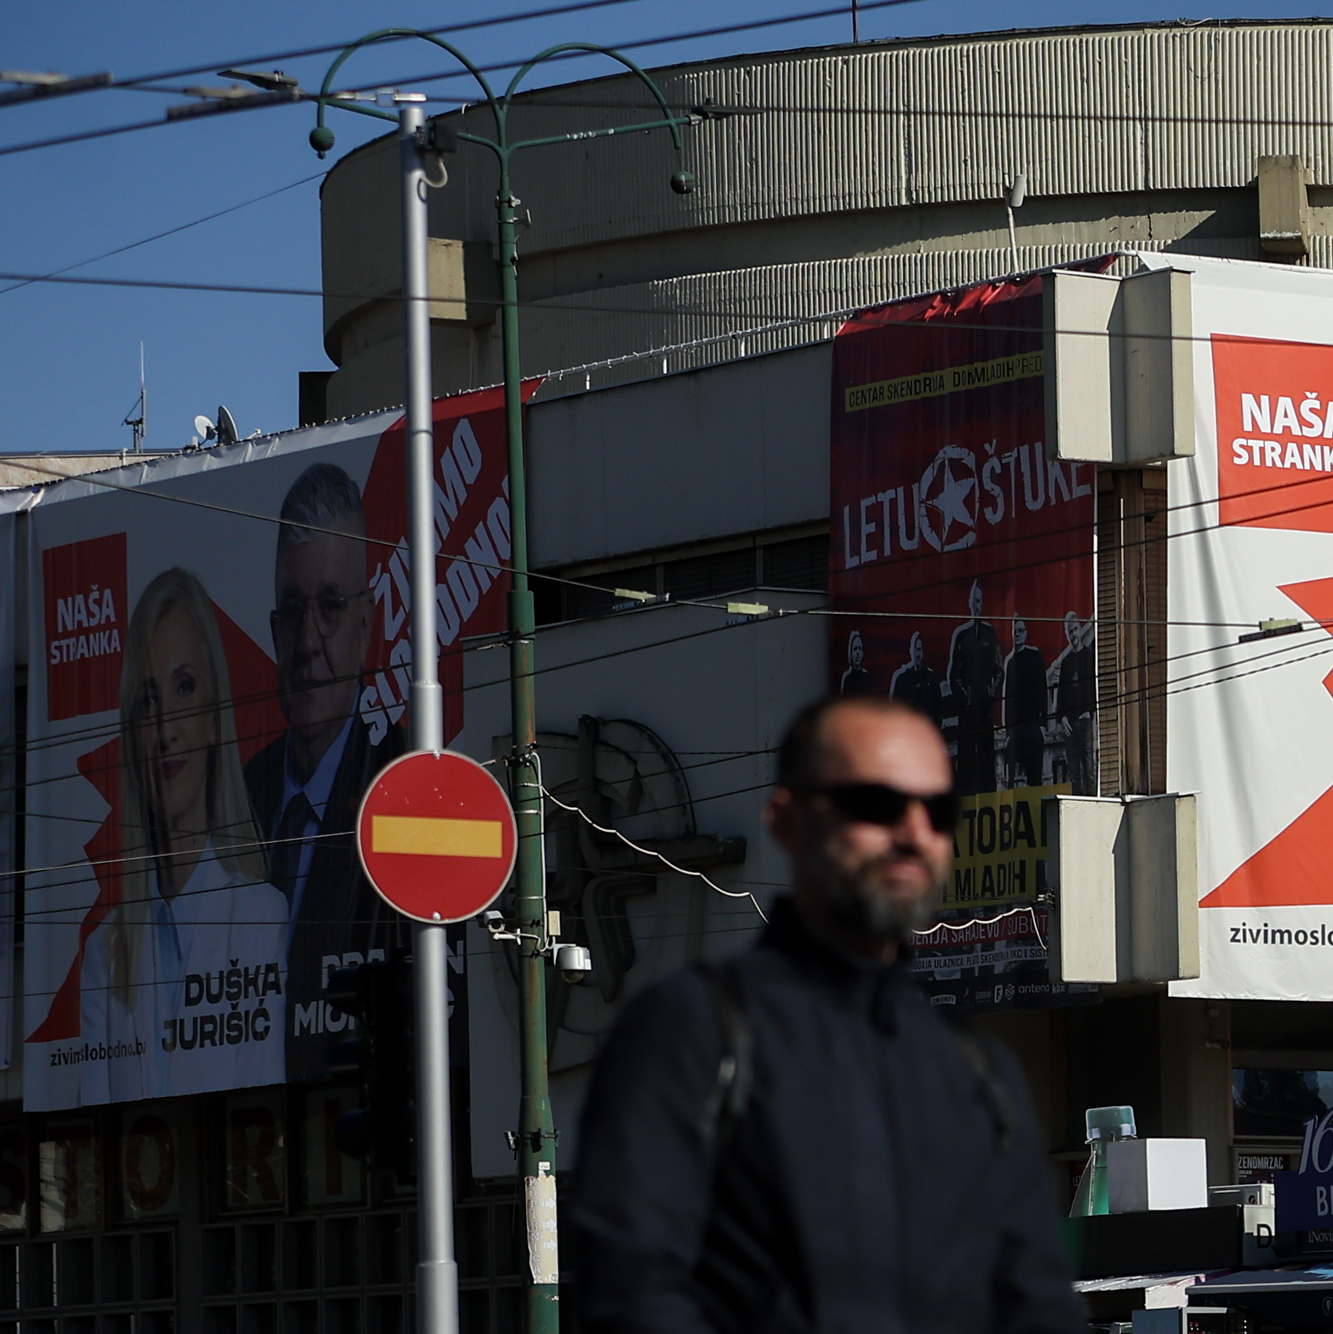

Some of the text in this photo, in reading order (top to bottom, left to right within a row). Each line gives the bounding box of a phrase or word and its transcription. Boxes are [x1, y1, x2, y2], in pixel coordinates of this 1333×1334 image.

[849, 386, 884, 407] CENTAR
[842, 480, 921, 570] LETU
[57, 584, 116, 633] NAŠA
[51, 629, 122, 665] STRANKA
[956, 859, 1026, 901] MLADIH
[184, 958, 282, 1007] DUŠKA
[162, 999, 271, 1053] JURIŠIĆ
